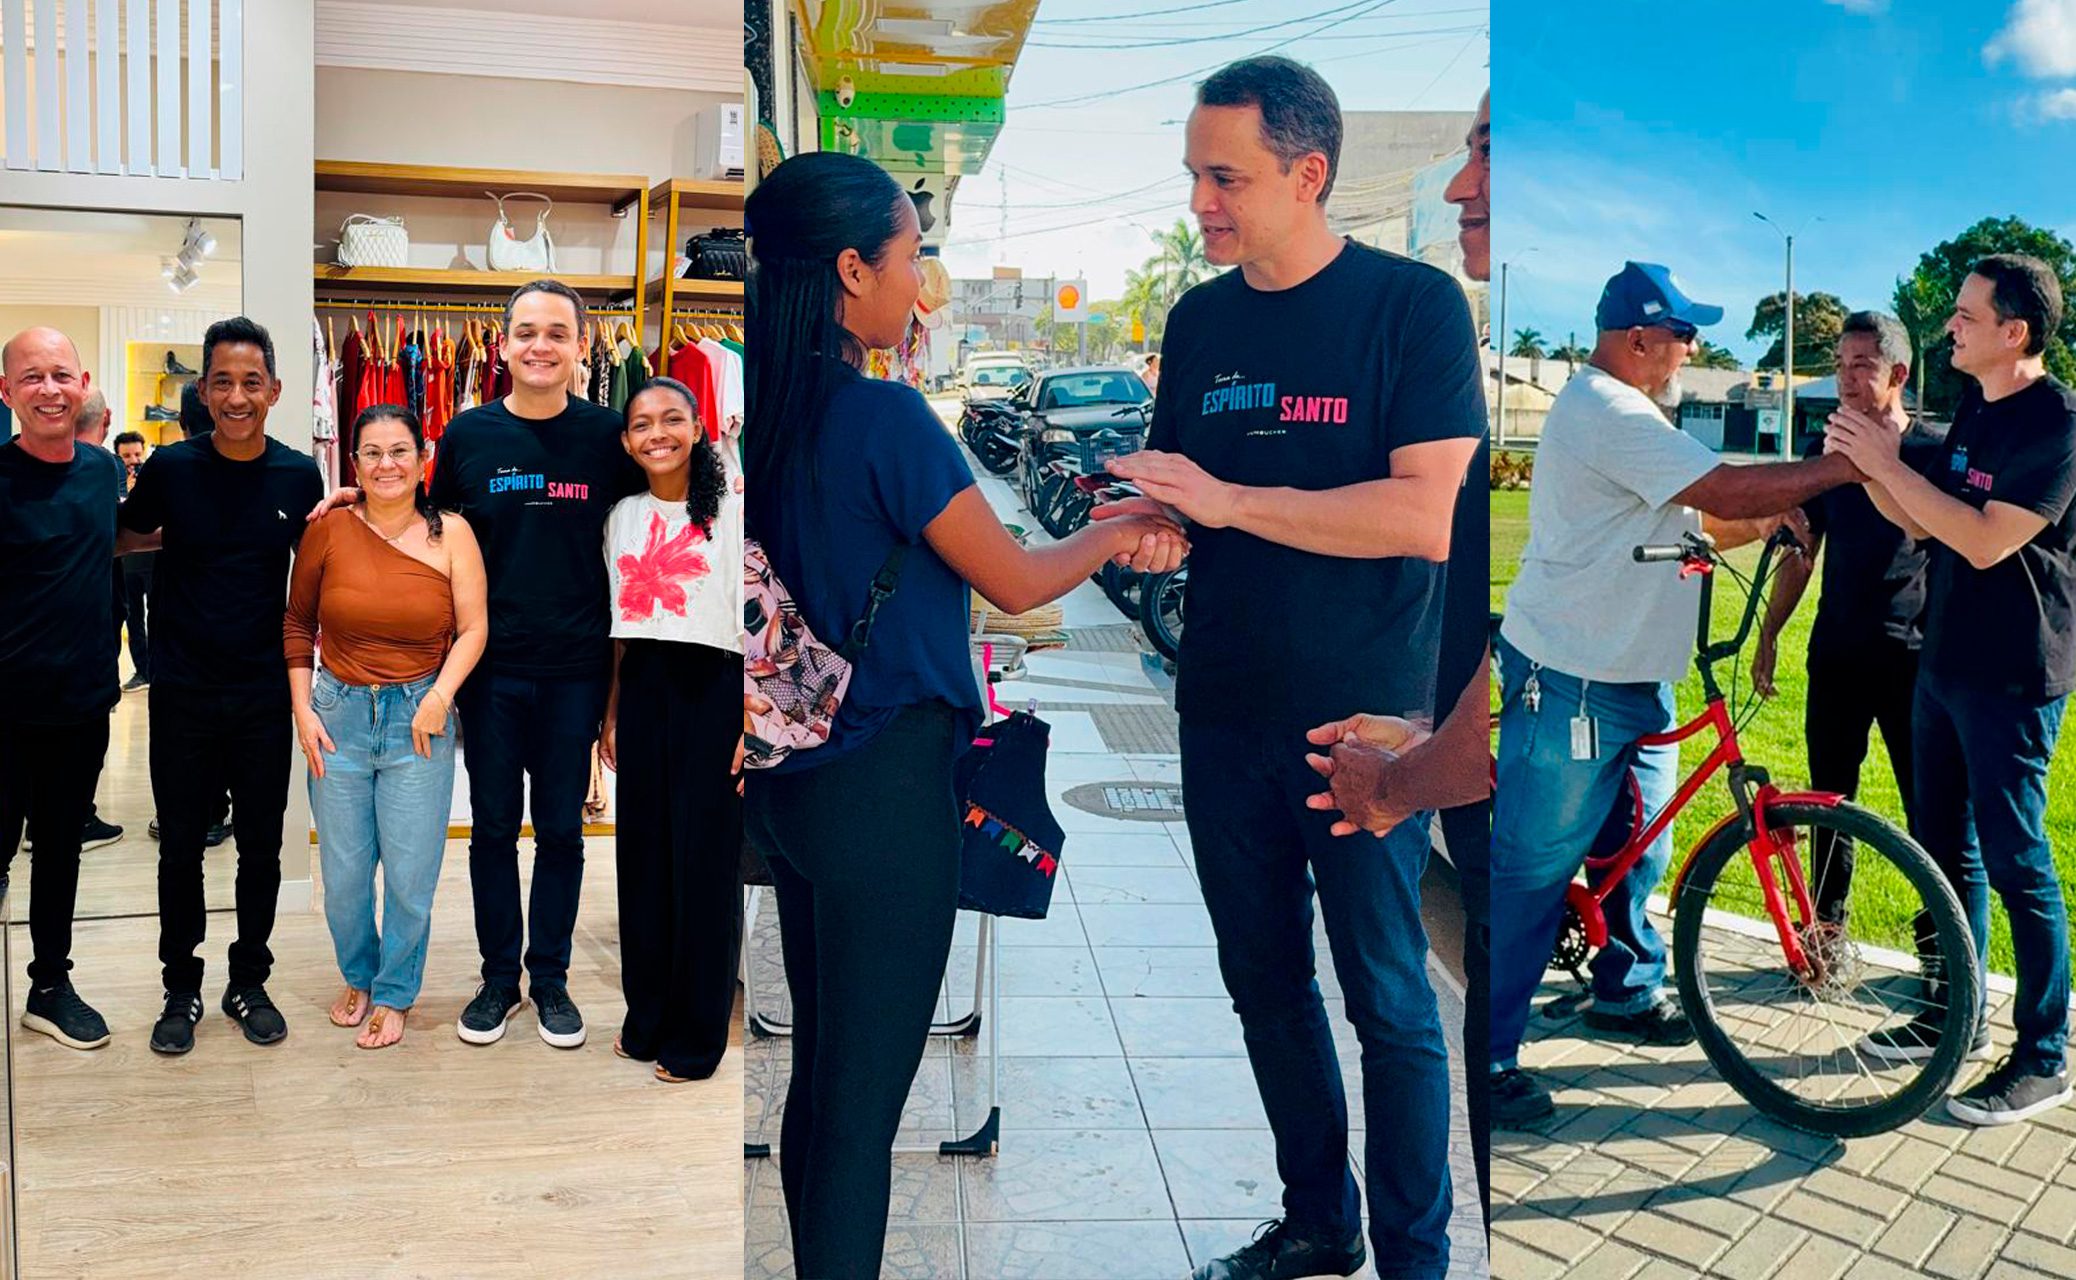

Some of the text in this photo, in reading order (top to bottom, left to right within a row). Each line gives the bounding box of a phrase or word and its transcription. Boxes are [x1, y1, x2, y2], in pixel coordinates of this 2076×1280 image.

[1202, 380, 1348, 423] ESPÍRITO SANTO
[490, 473, 589, 499] ESPÍRITO SANTO
